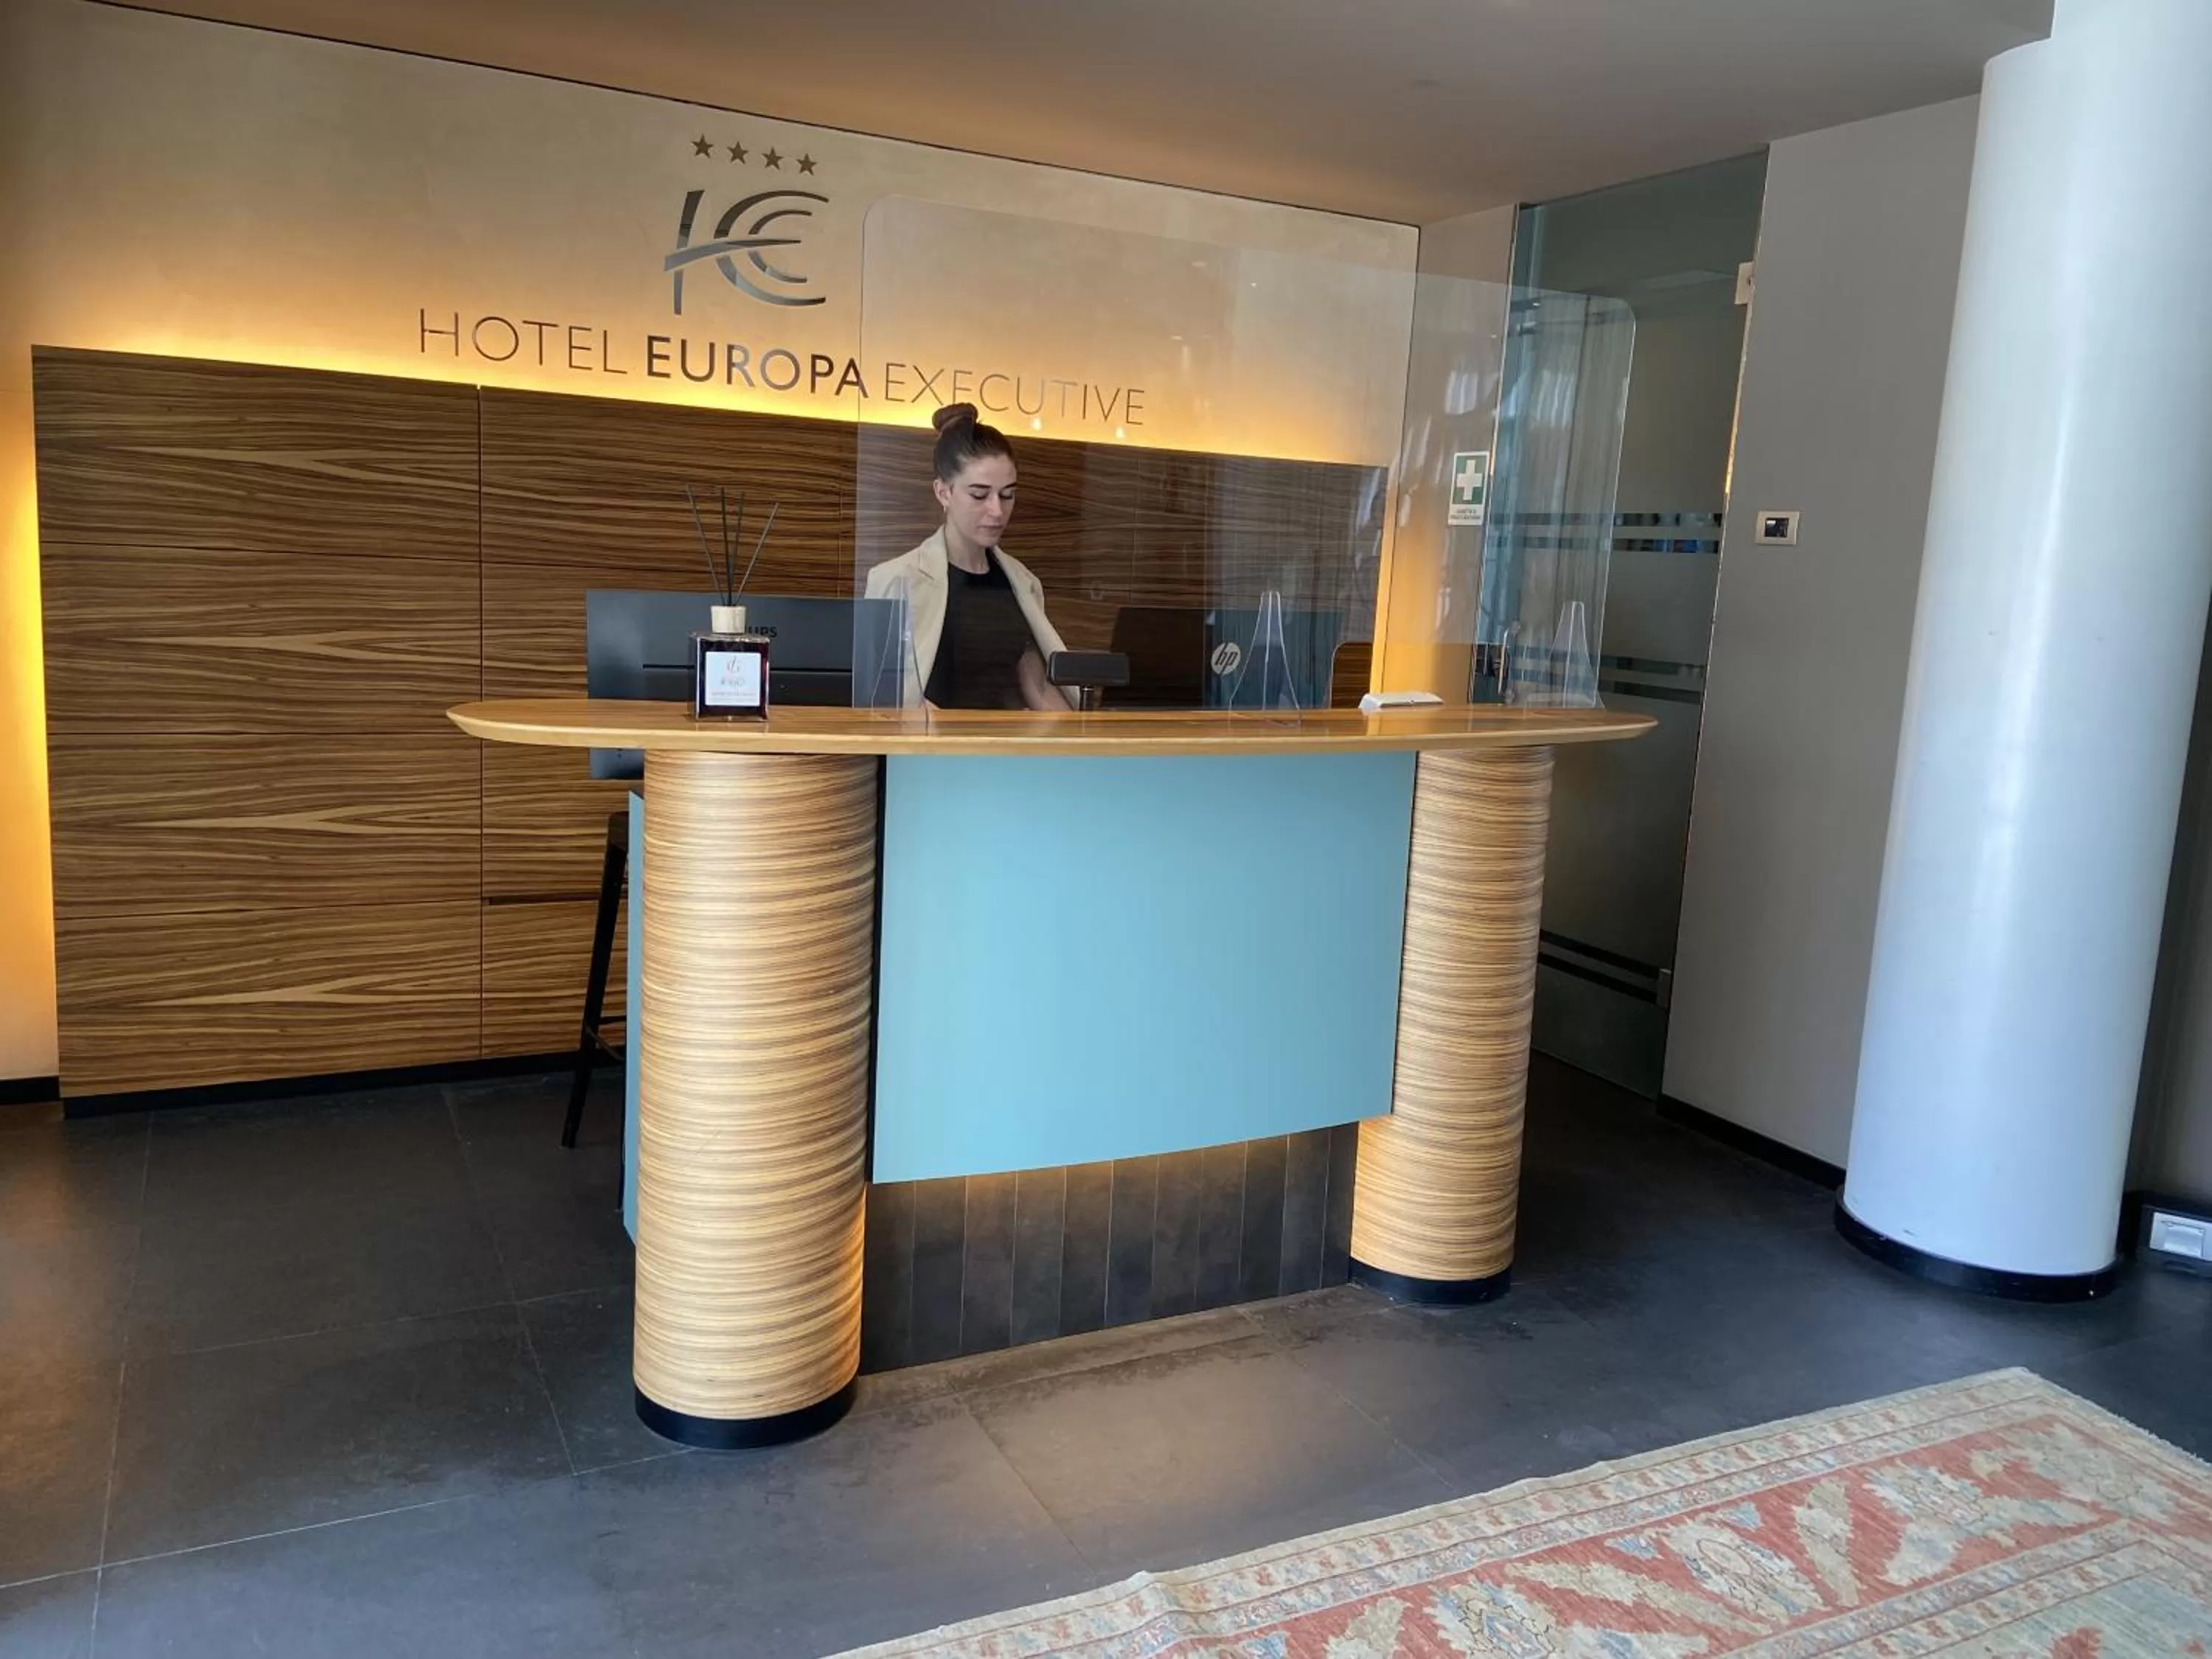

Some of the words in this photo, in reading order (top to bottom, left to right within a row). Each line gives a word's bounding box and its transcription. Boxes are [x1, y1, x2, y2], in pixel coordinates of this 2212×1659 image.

[420, 307, 628, 375] HOTEL
[647, 334, 869, 399] EUROPA
[884, 362, 1145, 425] EXECUTIVE
[1213, 641, 1239, 674] hp
